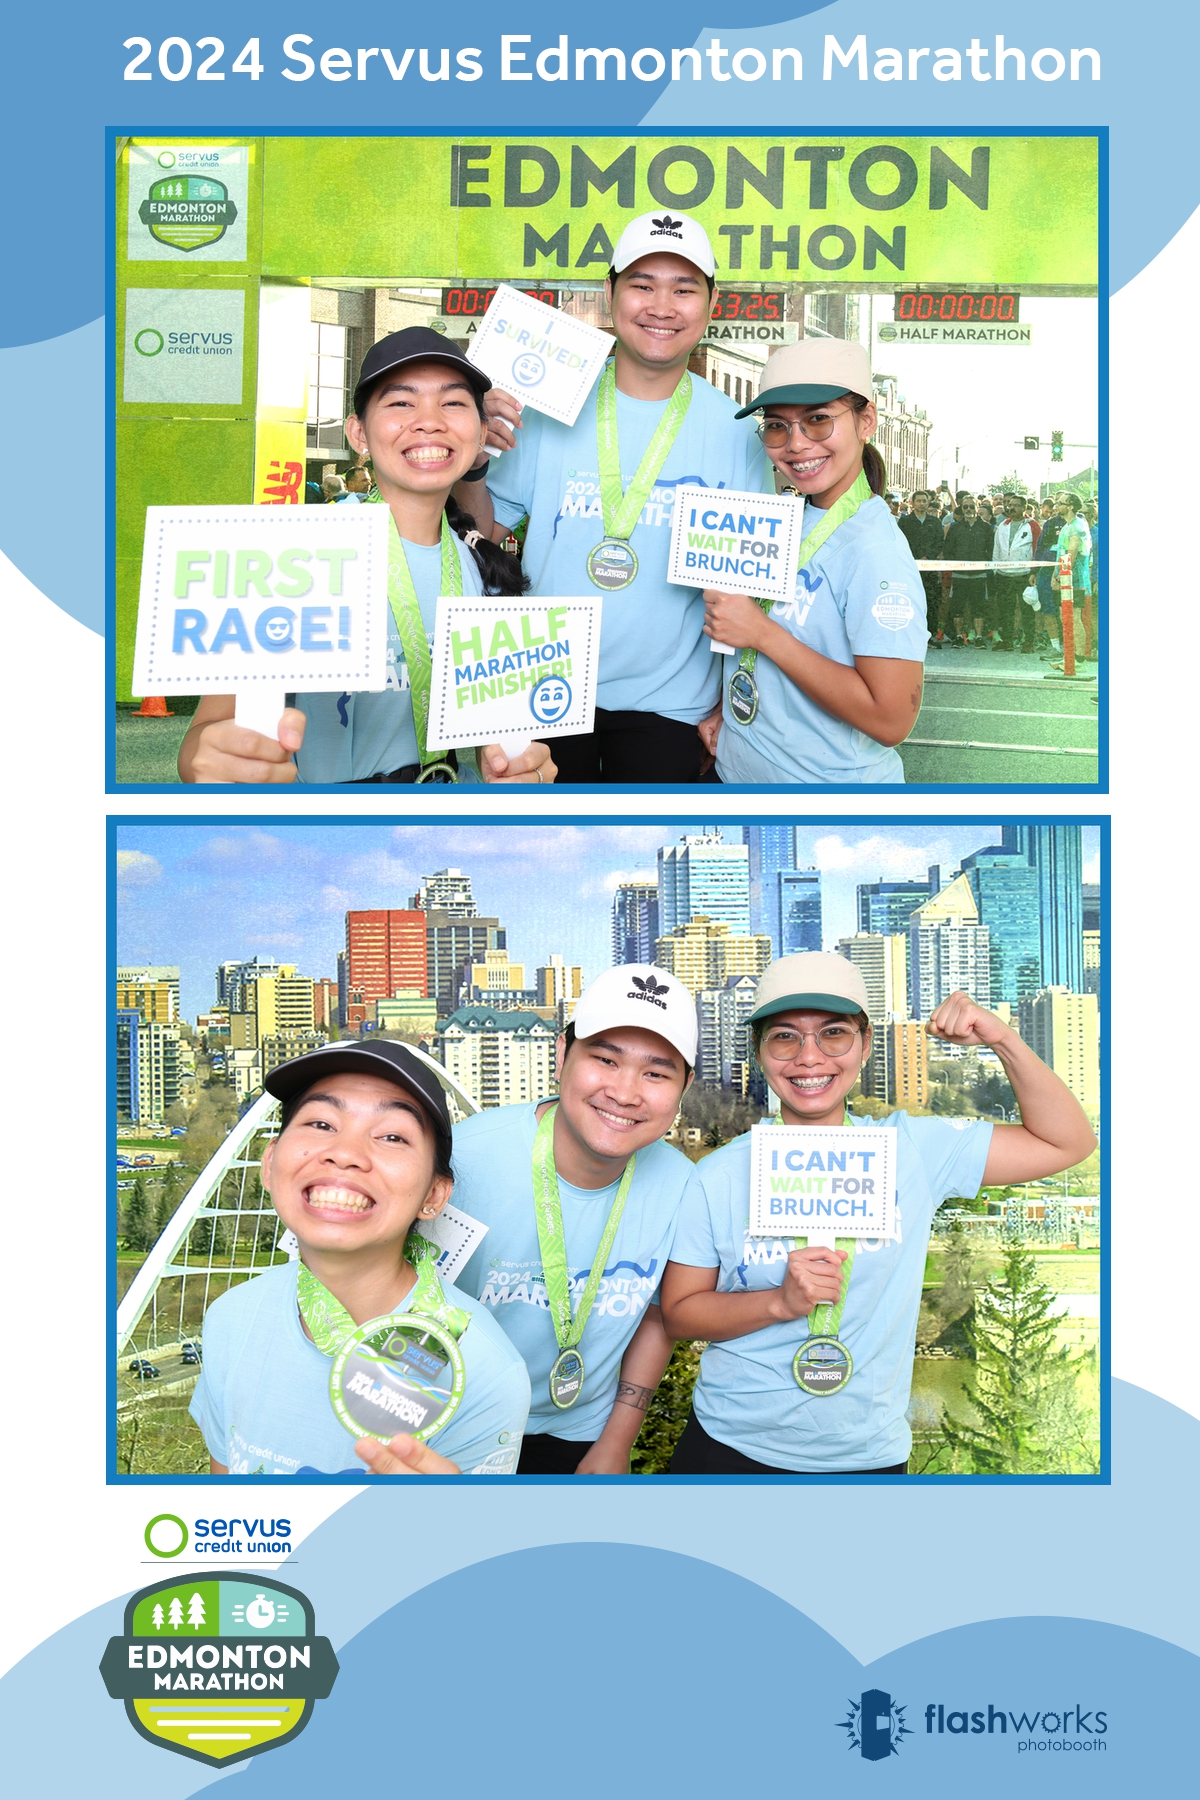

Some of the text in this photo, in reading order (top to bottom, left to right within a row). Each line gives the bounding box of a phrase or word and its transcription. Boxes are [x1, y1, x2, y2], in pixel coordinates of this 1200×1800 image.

[178, 152, 219, 161] servus
[450, 144, 990, 211] EDMONTON
[150, 203, 227, 214] EDMONTON
[160, 214, 215, 223] MARATHON
[650, 229, 683, 239] adidas
[523, 223, 906, 271] MATHON
[168, 332, 233, 345] servus
[545, 320, 554, 335] I
[900, 328, 939, 340] HALF
[943, 328, 1030, 341] MARATHON
[168, 345, 233, 355] credit union
[494, 319, 588, 373] SURVIVED!
[689, 508, 697, 527] I
[687, 531, 738, 554] WAIT
[739, 539, 780, 560] FOR
[173, 547, 358, 599] FIRST
[684, 551, 776, 581] BRUNCH.
[172, 605, 352, 655] RACE!
[394, 577, 423, 668] servus credit union
[451, 606, 568, 666] HALF
[455, 640, 570, 685] MARATHON
[456, 658, 573, 709] FINISHER!
[626, 991, 668, 1010] adidas
[771, 1151, 778, 1171] I
[770, 1176, 875, 1196] WAIT FOR
[770, 1198, 874, 1218] BRUNCH.
[501, 1260, 529, 1268] servus
[486, 1270, 531, 1286] 2024
[405, 1345, 442, 1370] servus
[345, 1378, 425, 1428] MARATHON
[379, 1385, 428, 1417] EDMONTON
[247, 1444, 298, 1468] credit union
